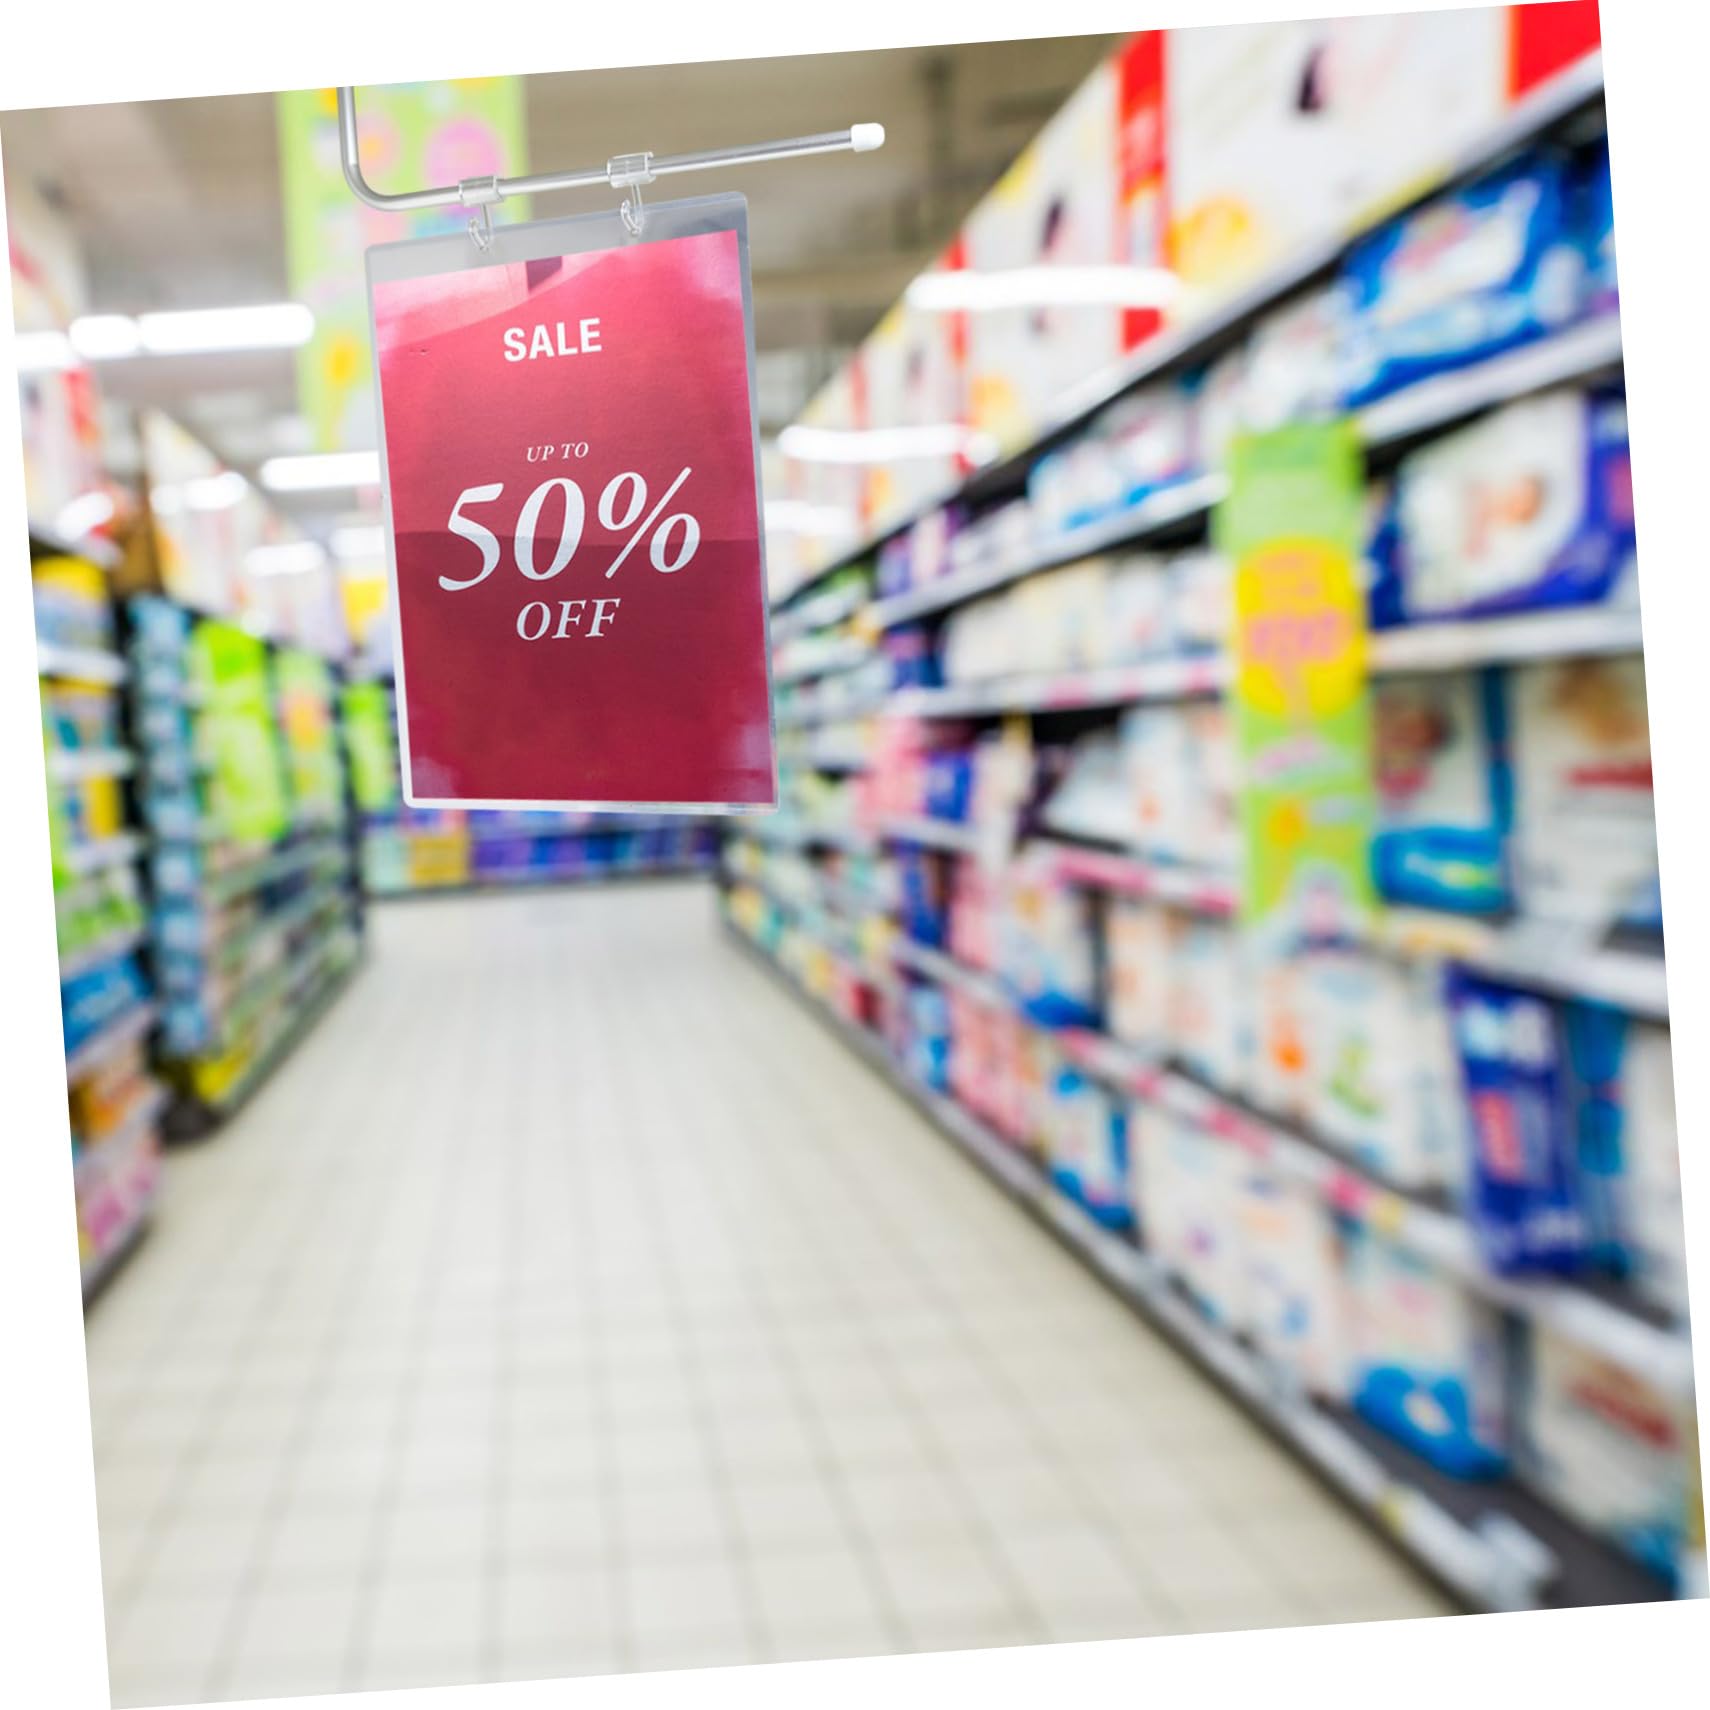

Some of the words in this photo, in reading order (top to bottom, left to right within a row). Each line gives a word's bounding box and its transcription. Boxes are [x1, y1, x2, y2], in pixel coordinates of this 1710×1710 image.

[502, 316, 603, 363] SALE
[525, 444, 556, 464] UP
[561, 440, 590, 461] TO
[438, 466, 701, 592] 50%
[515, 597, 622, 641] OFF
